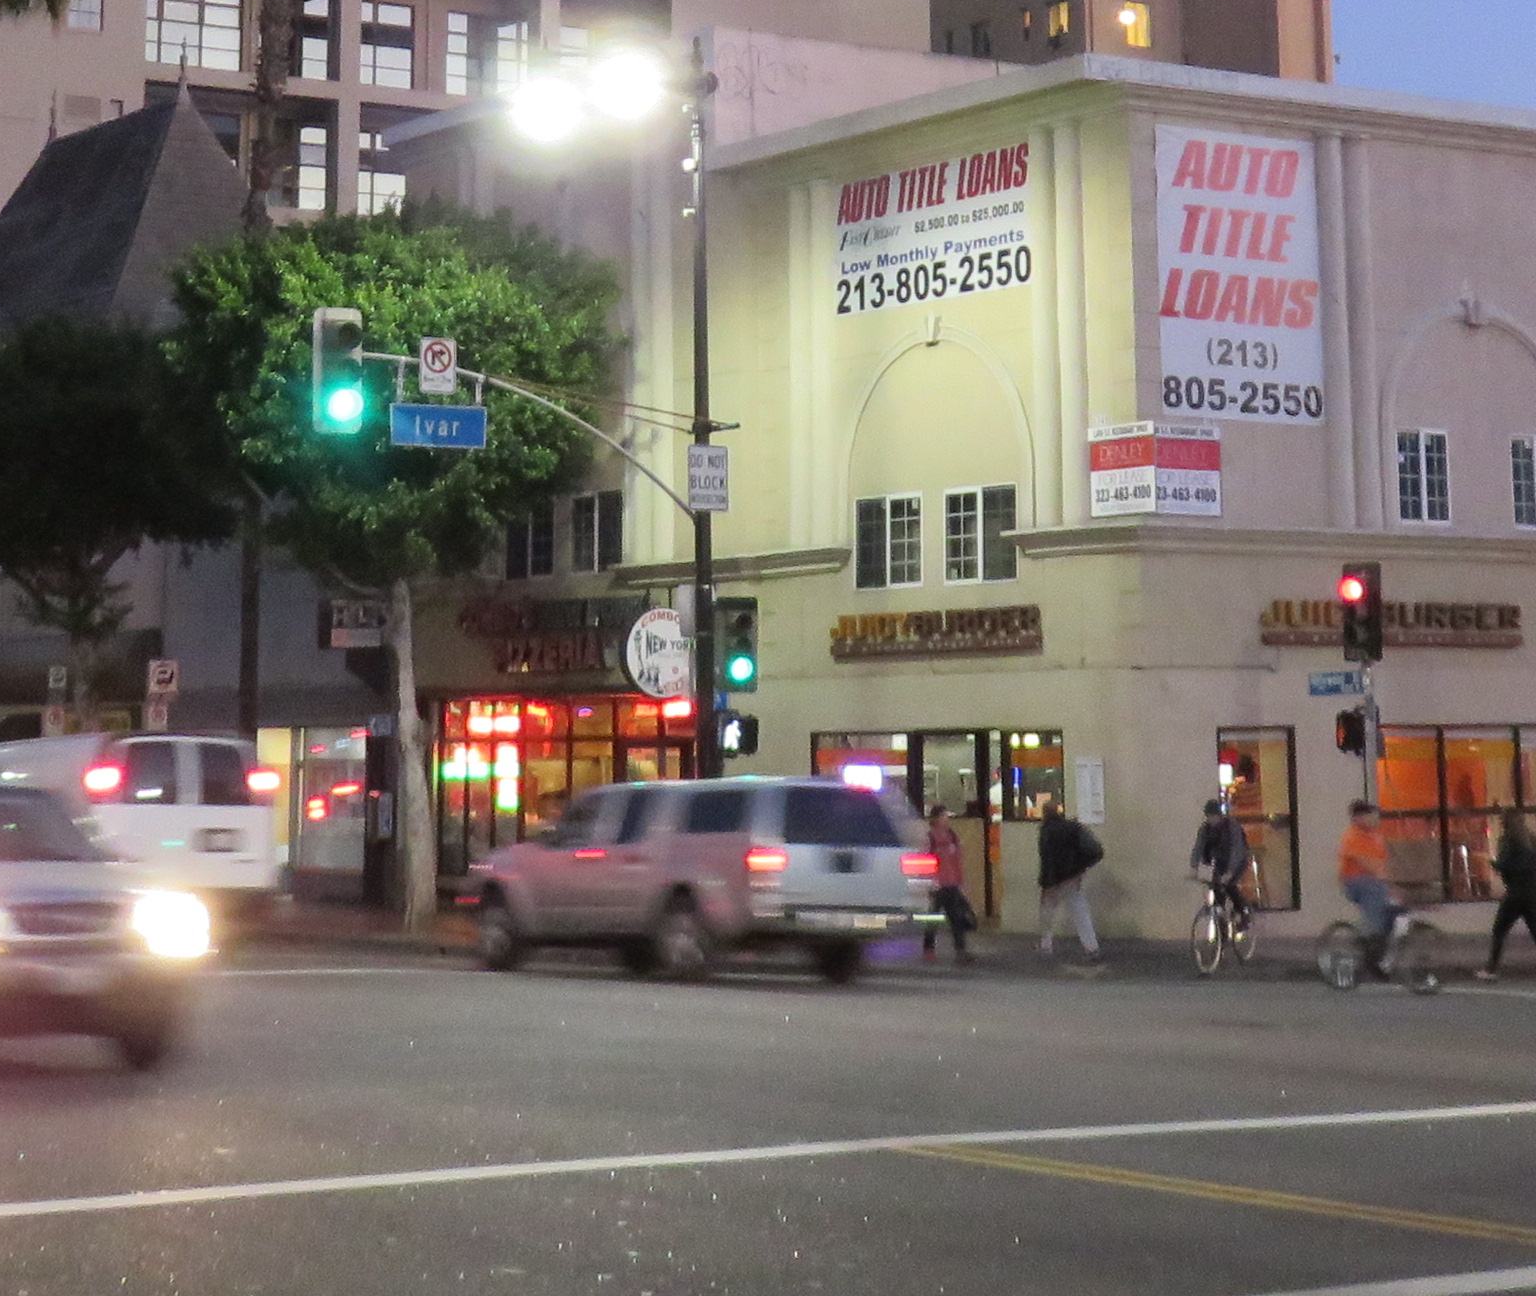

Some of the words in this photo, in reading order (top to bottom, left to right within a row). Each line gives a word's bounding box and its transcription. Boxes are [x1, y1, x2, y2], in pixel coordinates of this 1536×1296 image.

[837, 174, 892, 226] AUTO
[897, 161, 950, 214] TITLE
[956, 142, 1030, 201] LOANS
[1171, 140, 1299, 199] AUTO
[842, 259, 871, 276] Low
[877, 246, 939, 268] Monthly
[944, 228, 1026, 255] Payments
[1179, 204, 1297, 263] TITLE
[836, 245, 1032, 316] 213-805-2550
[1159, 267, 1320, 330] LOANS
[1206, 337, 1278, 371] (213)
[1163, 375, 1324, 420] 805-2550
[415, 414, 460, 437] Ivar
[690, 454, 703, 468] DO
[708, 454, 725, 469] NOT
[690, 474, 725, 490] BLOCK
[1156, 486, 1217, 503] 23-463-4100
[641, 611, 680, 629] COMBO
[646, 629, 668, 660] NEW
